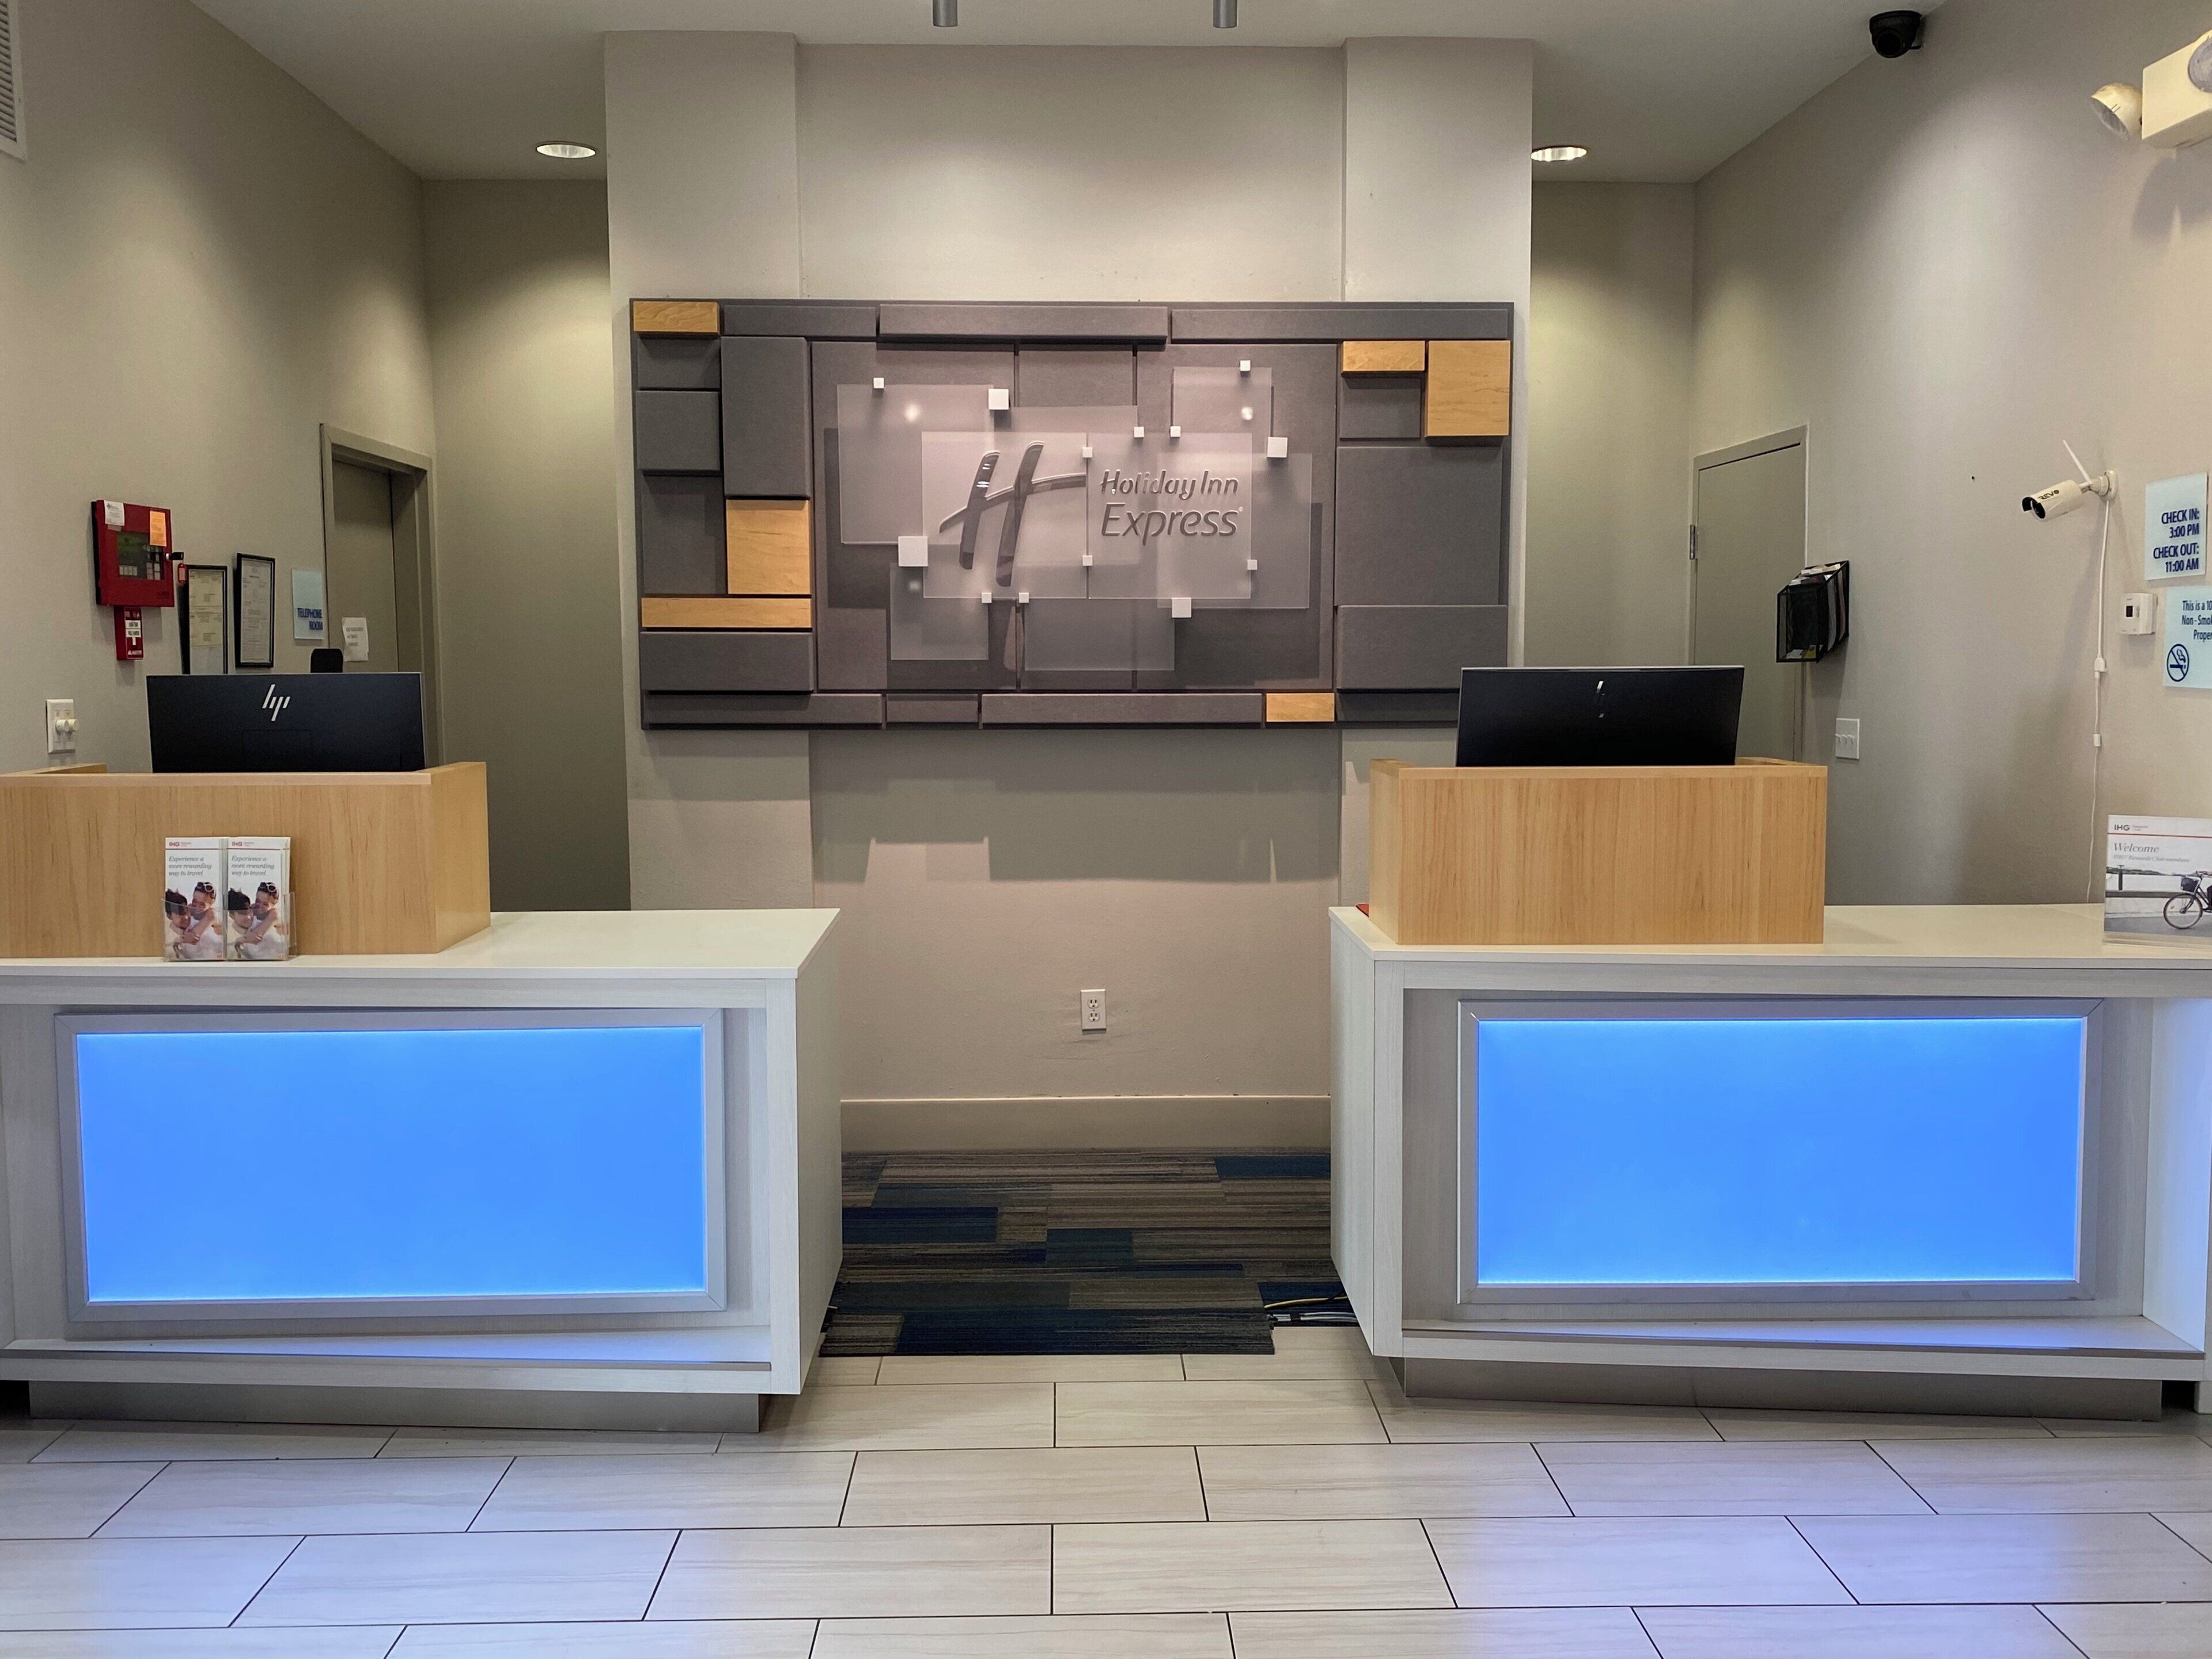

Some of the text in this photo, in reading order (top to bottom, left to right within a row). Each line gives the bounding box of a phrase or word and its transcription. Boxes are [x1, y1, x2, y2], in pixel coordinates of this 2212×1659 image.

[1100, 469, 1238, 500] Holiday Inn
[1101, 502, 1239, 546] Express
[2161, 508, 2199, 524] CHECK IN:
[2169, 522, 2199, 538] 3:00 PM
[2153, 542, 2199, 559] CHECK OUT:
[2165, 558, 2199, 573] 11:00 AM
[297, 608, 323, 619] TELEPHONE
[2182, 600, 2194, 611] This
[2195, 600, 2200, 611] is
[2201, 603, 2205, 611] a
[309, 620, 323, 630] ROOM
[262, 684, 290, 721] hp
[2114, 842, 2160, 853] Welcome
